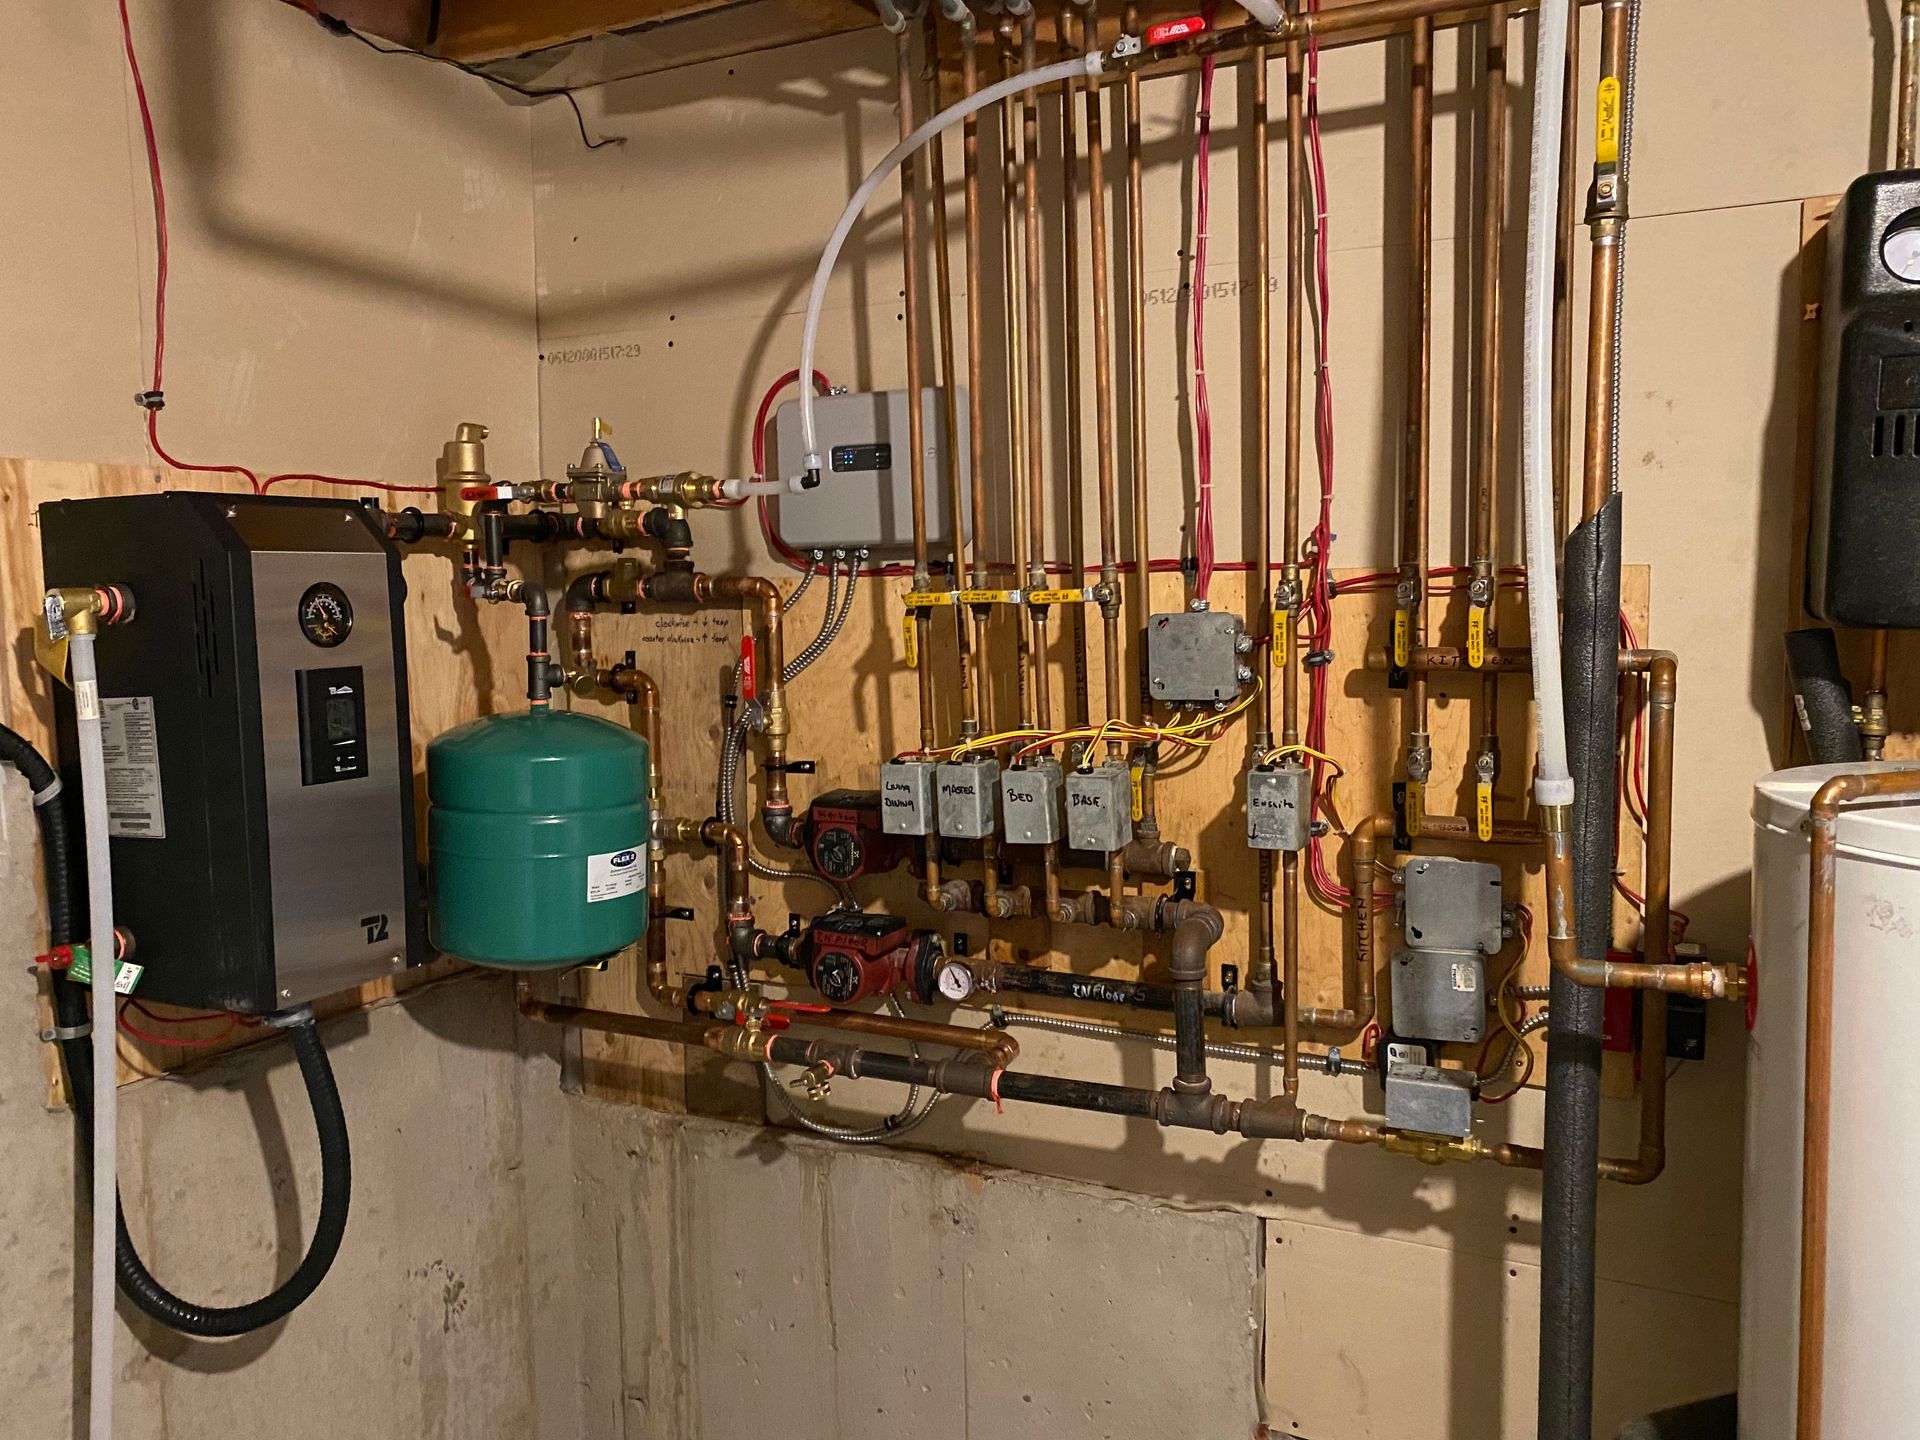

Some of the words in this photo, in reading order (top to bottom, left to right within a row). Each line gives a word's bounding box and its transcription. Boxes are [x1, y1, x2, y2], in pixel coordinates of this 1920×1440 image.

[942, 784, 976, 796] MASTER
[1007, 788, 1034, 803] BED
[1356, 897, 1369, 961] KITCHEN
